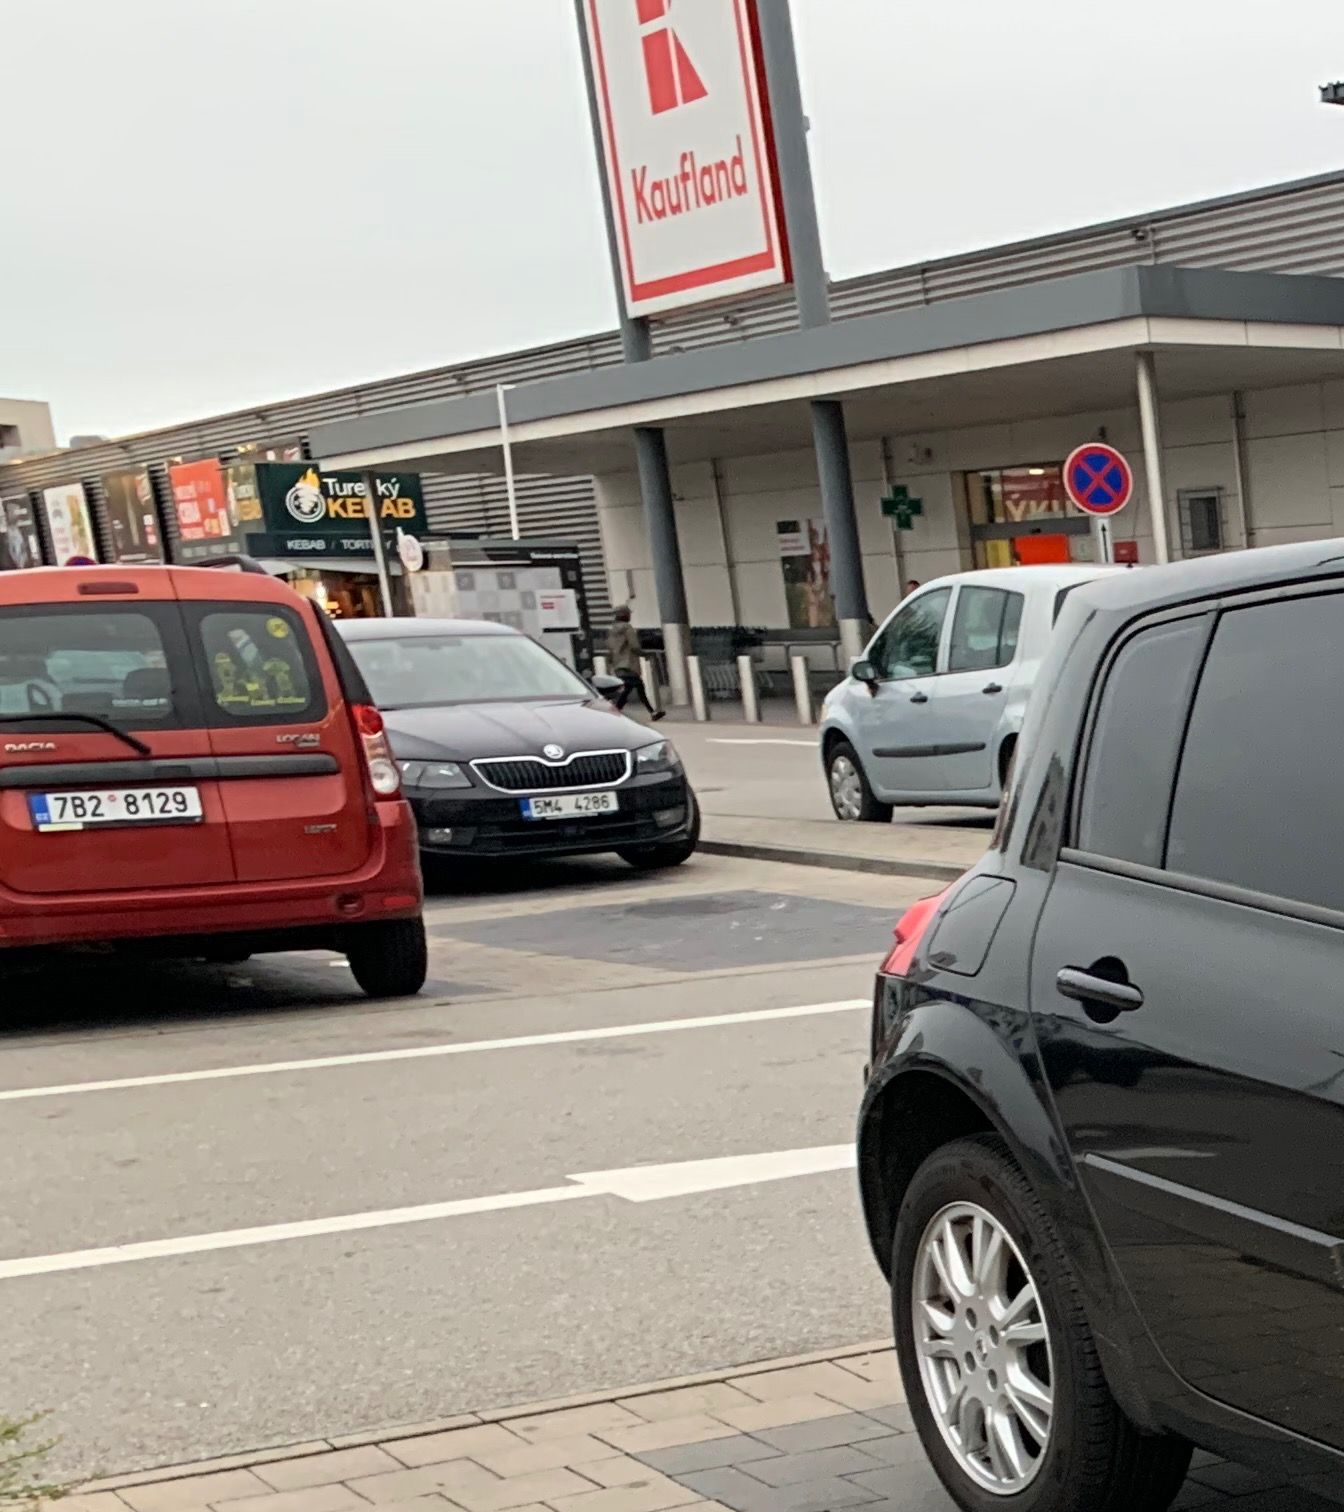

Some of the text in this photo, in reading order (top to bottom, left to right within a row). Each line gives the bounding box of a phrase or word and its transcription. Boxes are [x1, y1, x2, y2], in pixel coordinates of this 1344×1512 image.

[631, 134, 748, 224] Kaufland
[321, 477, 400, 500] Tureký
[286, 539, 326, 550] KEBAB
[53, 792, 188, 819] 7B2 8129
[534, 800, 562, 814] 5M4
